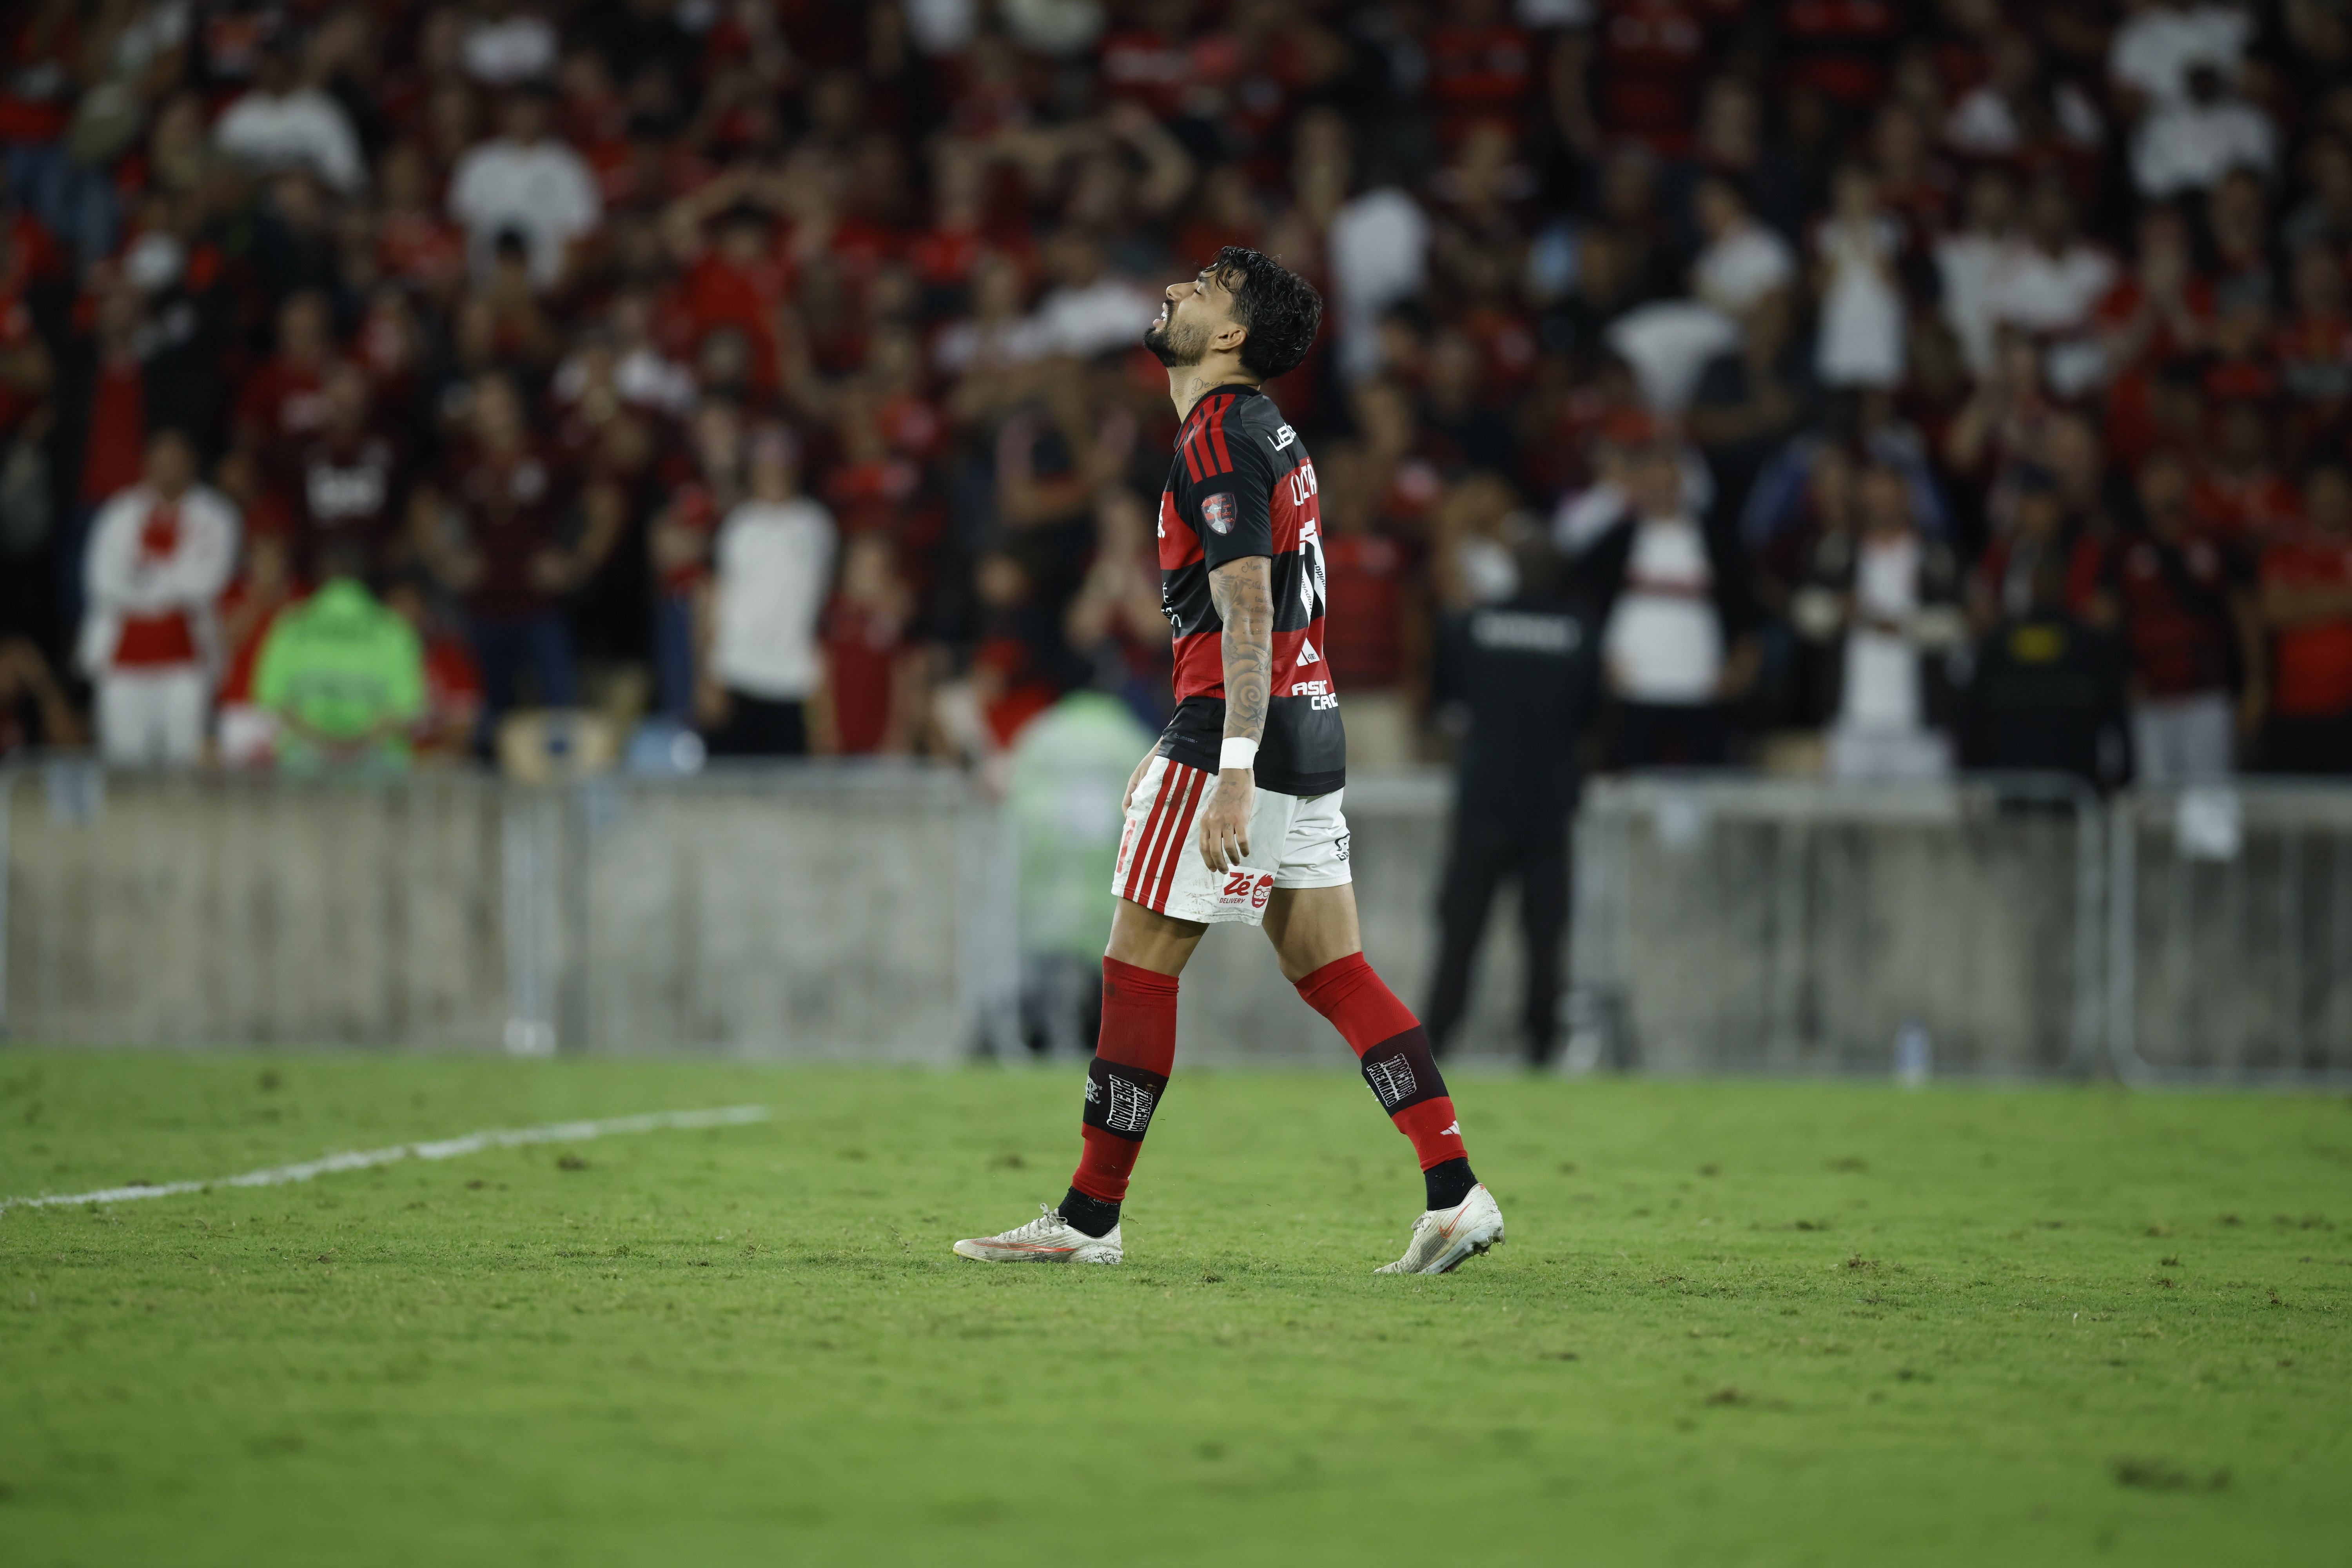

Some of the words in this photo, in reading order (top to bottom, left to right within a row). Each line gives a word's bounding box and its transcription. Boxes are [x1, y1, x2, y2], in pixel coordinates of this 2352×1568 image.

[1224, 872, 1254, 896] Zé
[1106, 1074, 1135, 1131] PREMIADO
[1367, 1062, 1399, 1107] PREMIADO
[1129, 1087, 1153, 1131] TORCEDOR
